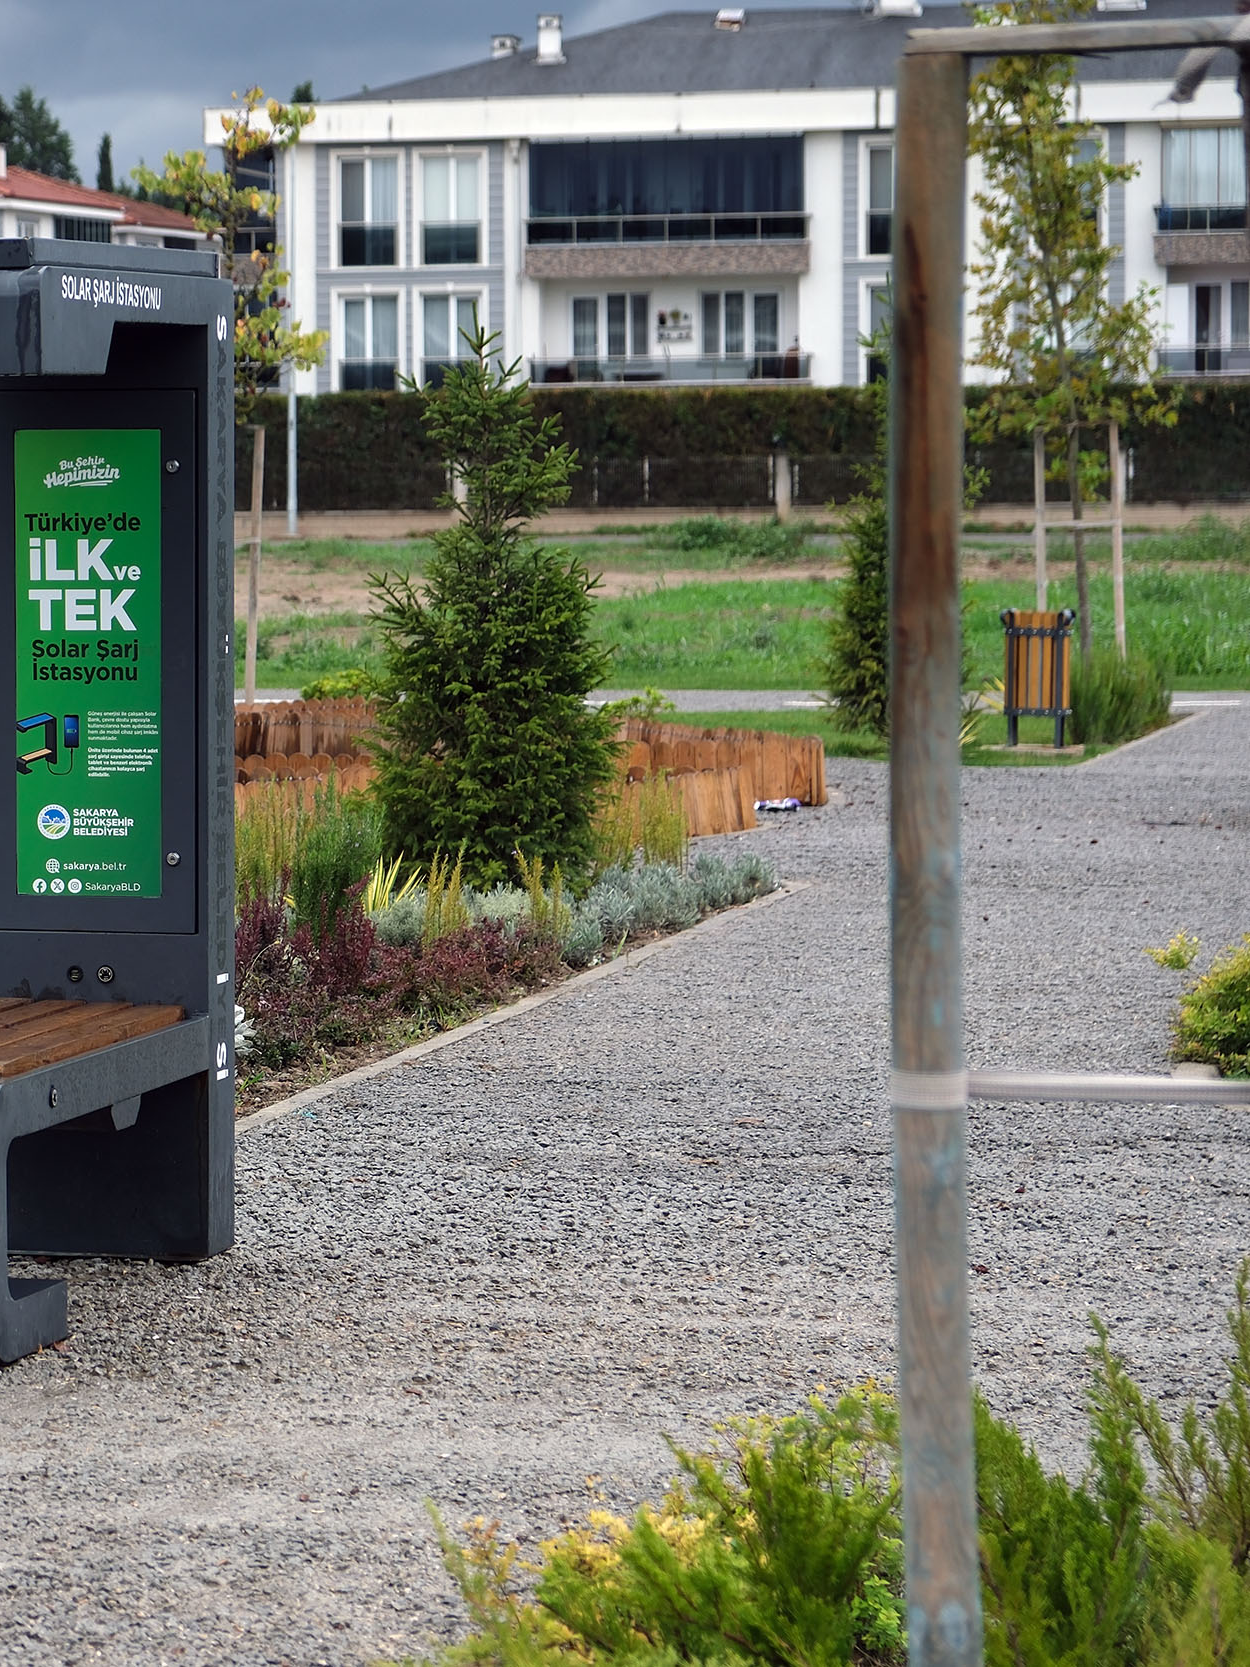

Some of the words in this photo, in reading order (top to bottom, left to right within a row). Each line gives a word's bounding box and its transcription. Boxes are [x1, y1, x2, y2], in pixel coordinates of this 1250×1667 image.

[61, 274, 92, 301] SOLAR
[93, 278, 115, 308] ŞARJ
[116, 276, 162, 310] İSTASYONU
[58, 460, 74, 471] Bu
[75, 455, 105, 470] Şehir
[43, 464, 121, 489] Hepimizin
[113, 565, 141, 581] ve
[28, 589, 137, 631] TEK
[31, 639, 89, 658] Solar
[96, 639, 139, 662] Şarj
[32, 658, 138, 685] İstasyonu
[73, 809, 119, 817] SAKARYA
[73, 817, 134, 827] BÜYÜKŞEHİR
[73, 827, 128, 836] BELEDİYESİ
[63, 862, 126, 872] sakarya.bel.tr
[85, 883, 141, 893] SakaryaBLD
